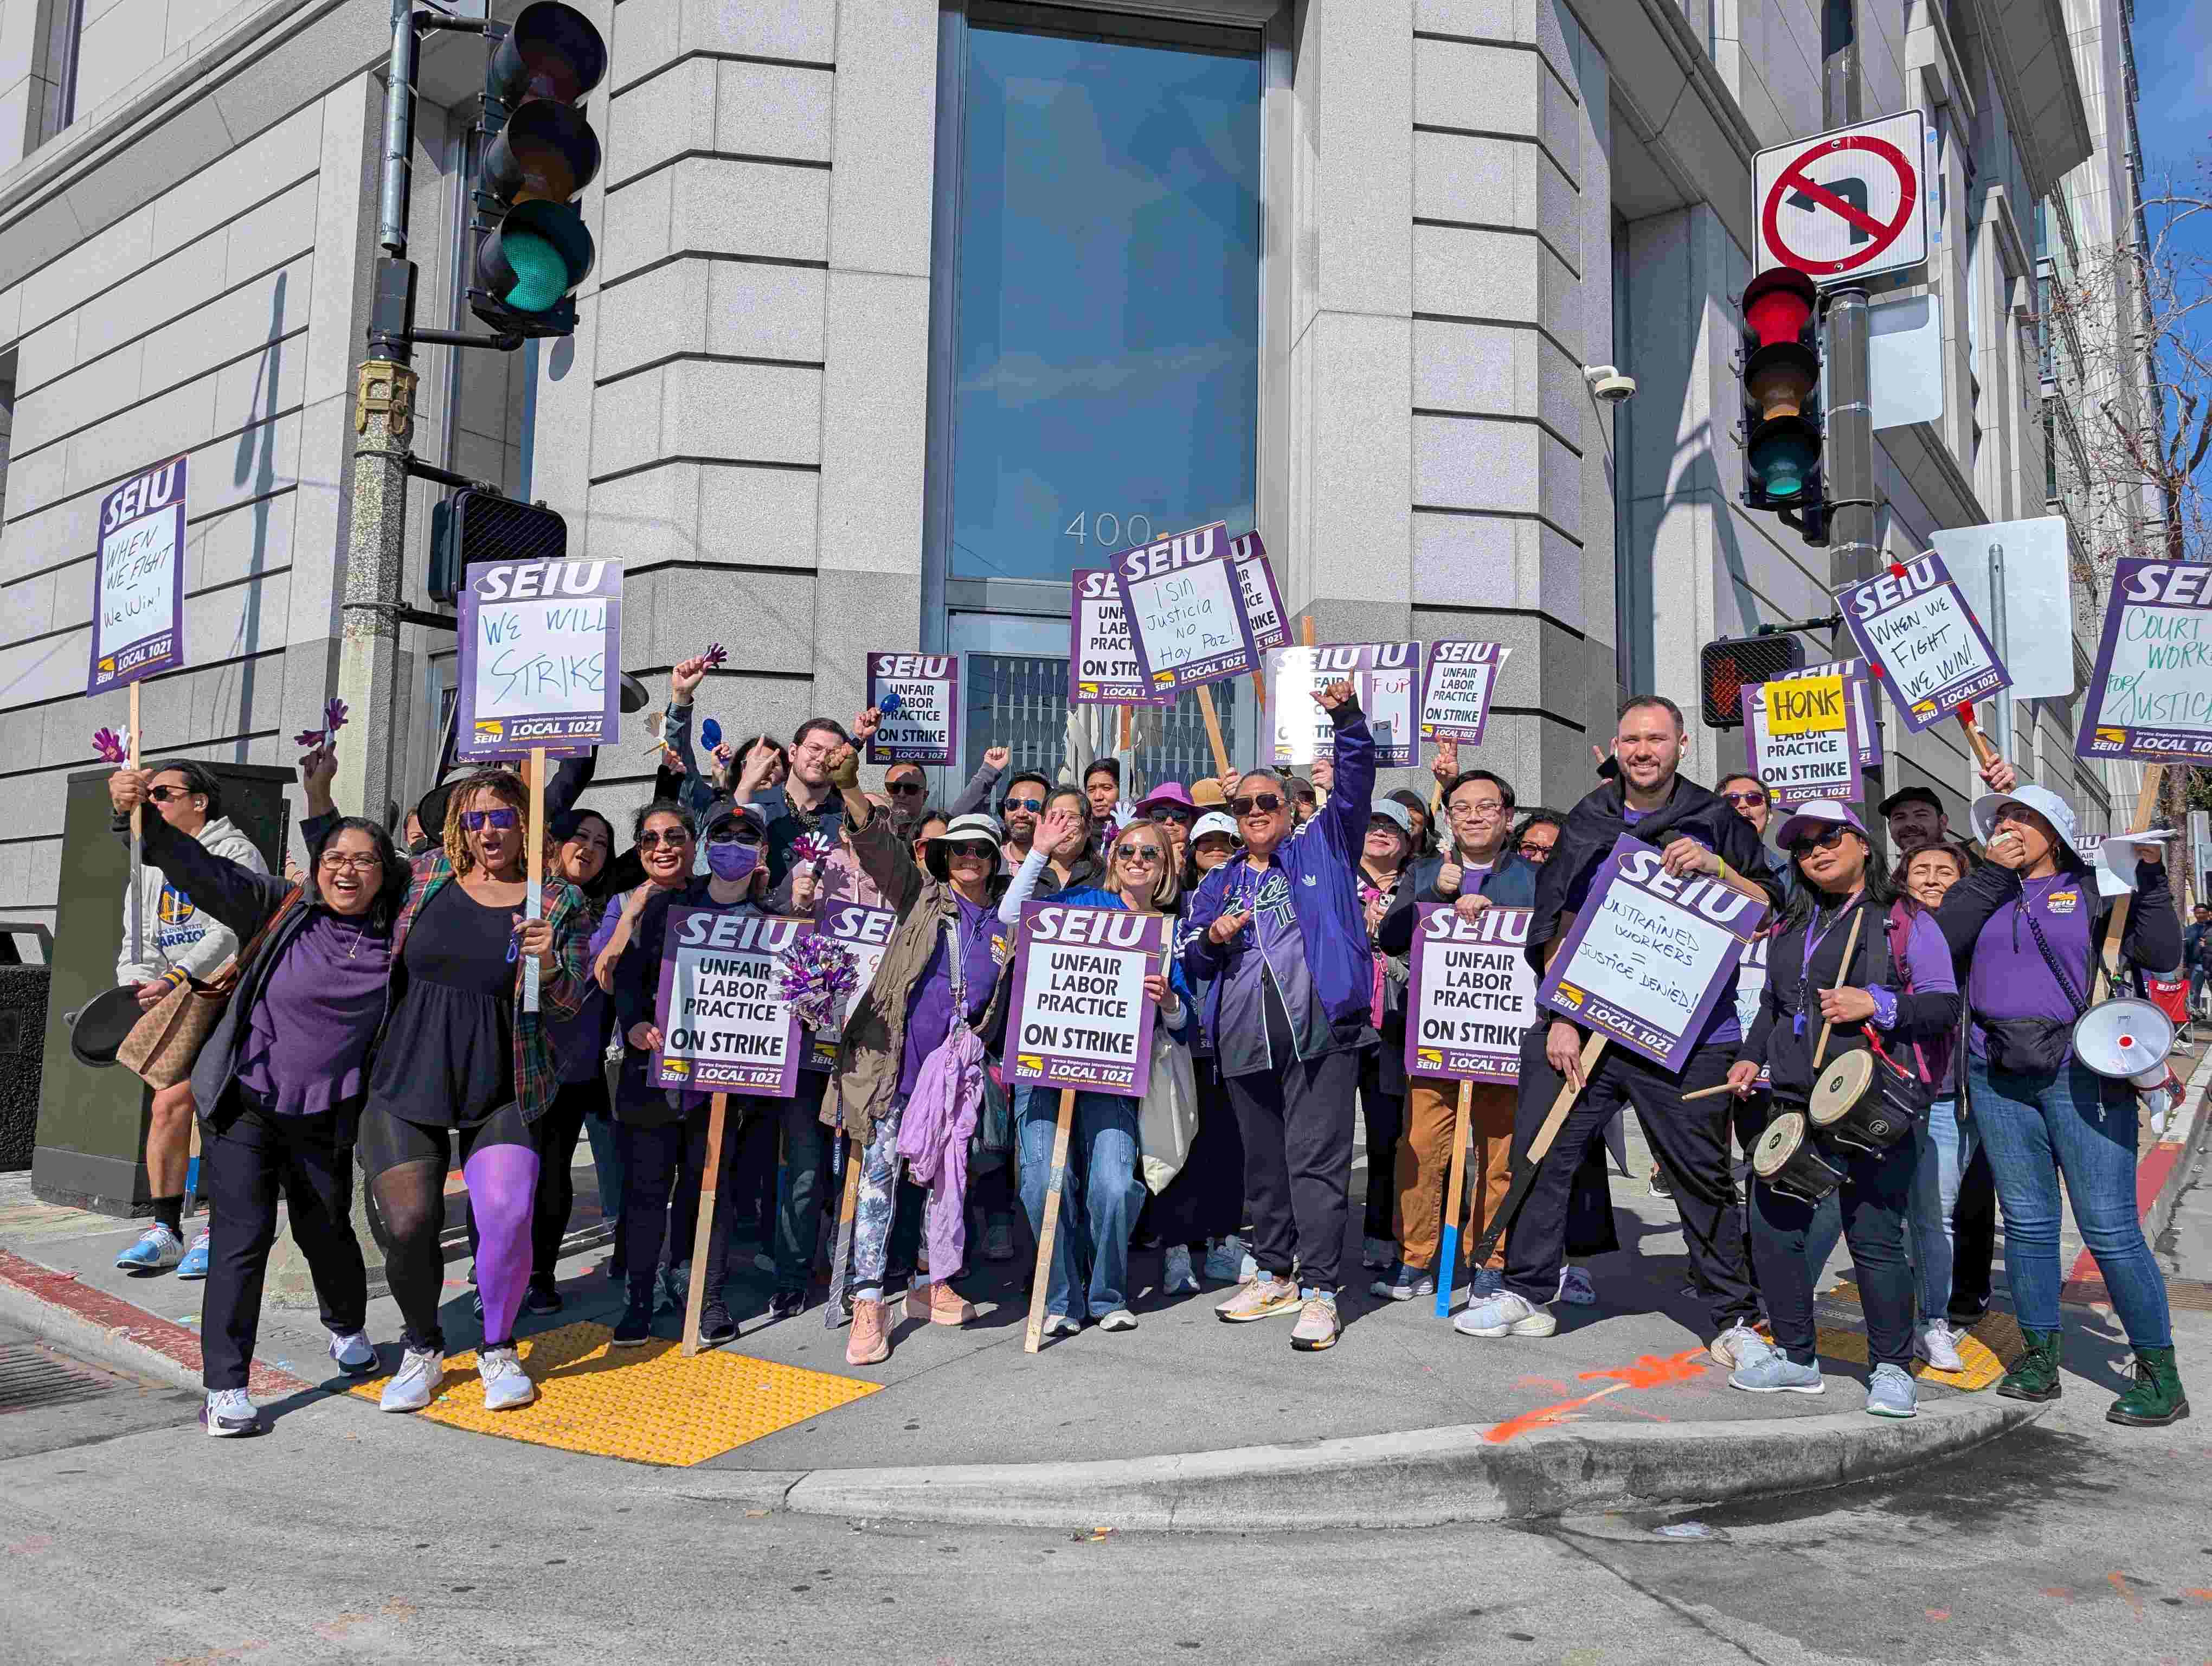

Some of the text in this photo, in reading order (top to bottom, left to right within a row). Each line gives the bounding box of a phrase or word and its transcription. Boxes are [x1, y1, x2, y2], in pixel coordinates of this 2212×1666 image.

[104, 462, 177, 530] SEIU
[1063, 511, 1150, 547] 400
[106, 526, 158, 572] WHEN
[1126, 528, 1214, 582] SEIU
[107, 543, 173, 590] WE FIGHT
[480, 561, 605, 600] SEIU
[1083, 573, 1120, 597] SE
[1856, 557, 1936, 619] SEIU
[2127, 565, 2212, 605] SEI
[104, 587, 160, 629] We Win!
[1098, 606, 1126, 619] UNF
[483, 607, 615, 645] WE WILL
[1099, 622, 1128, 635] LAB
[1250, 610, 1276, 630] RIKE
[1869, 597, 1950, 645] WHEN WE
[2126, 607, 2203, 641] COURT
[1090, 637, 1133, 650] PRACT
[1160, 645, 1191, 665] Hay
[1202, 621, 1235, 648] Paz!
[1264, 632, 1283, 645] 1021
[1891, 624, 1951, 668] FIGHT
[118, 648, 145, 669] LOCAL
[149, 639, 172, 656] 1021
[1317, 648, 1361, 669] IU
[1372, 643, 1408, 669] IU
[1436, 642, 1493, 662] SEIU
[2150, 642, 2212, 669] WORK
[876, 655, 948, 677] SEIU
[1083, 660, 1140, 676] ON STR
[1181, 664, 1218, 681] LOCAL
[1221, 655, 1246, 669] 1021
[1442, 667, 1477, 678] UNFAIR
[1903, 670, 1934, 697] WE
[1936, 634, 1977, 681] WIN!
[97, 671, 114, 685] SEIU
[491, 649, 606, 704] STRIKE
[1155, 680, 1175, 691] SEIU
[1314, 677, 1345, 688] FAIR
[1441, 680, 1474, 690] LABOR
[890, 684, 935, 695] UNFAIR
[1103, 687, 1138, 696] LOCAL
[1433, 690, 1478, 702] PRACTICE
[1941, 684, 1977, 707] LOCAL
[1978, 672, 1999, 689] 1021
[899, 697, 933, 708] ABOR
[1773, 688, 1841, 721] HONK
[883, 710, 941, 721] PRACTICE
[1425, 707, 1480, 722] ON STRIKE
[1917, 709, 1939, 724] SEIU
[473, 734, 503, 744] SEIU
[511, 721, 603, 736] LOCAL 1021
[877, 729, 946, 742] ON STRIKE
[896, 750, 925, 759] LOCAL
[1387, 750, 1410, 759] 1021
[1767, 740, 1837, 758] PRACTICE
[2091, 741, 2124, 751] SEIU
[2132, 738, 2212, 752] LOCAL 10
[1762, 761, 1847, 782] ON STRIKE
[1786, 789, 1823, 799] LOCAL
[1827, 786, 1851, 796] 1021
[1620, 850, 1751, 922] SEIU
[680, 912, 800, 952] SEIU
[834, 908, 898, 944] SEI
[1032, 907, 1147, 947] SEIU
[1426, 908, 1534, 943] SEIU
[1602, 896, 1700, 951] UNTRAINED
[157, 929, 206, 947] ARRIO
[1615, 924, 1693, 966] WORKERS
[699, 957, 771, 979] UNFAIR
[1051, 953, 1122, 976] UNFAIR
[1445, 951, 1515, 971] UNFAIR
[1051, 975, 1118, 996] LABOR
[1446, 971, 1512, 991] LABOR
[1578, 943, 1699, 1014] JUSTICE DENIED!
[698, 979, 768, 1000] LABOR
[684, 998, 777, 1022] PRACTICE
[1037, 994, 1128, 1018] PRACTICE
[1433, 990, 1523, 1012] PRACTICE
[1551, 994, 1579, 1011] SEIU
[1024, 1024, 1135, 1055] ON STRIKE
[1423, 1019, 1455, 1040] ON
[1587, 1005, 1636, 1035] LOCAL
[1638, 1031, 1675, 1053] 1021
[671, 1028, 784, 1057] ON STRIKE
[812, 1055, 834, 1066] SEIU
[1416, 1061, 1442, 1070] SEIU
[1449, 1057, 1496, 1071] LOCAL
[661, 1072, 689, 1081] SEIU
[697, 1068, 747, 1081] LOCAL
[750, 1071, 782, 1084] 1021
[1015, 1068, 1043, 1078] SEIU
[1050, 1064, 1097, 1079] LOCAL
[1102, 1069, 1134, 1082] 1021
